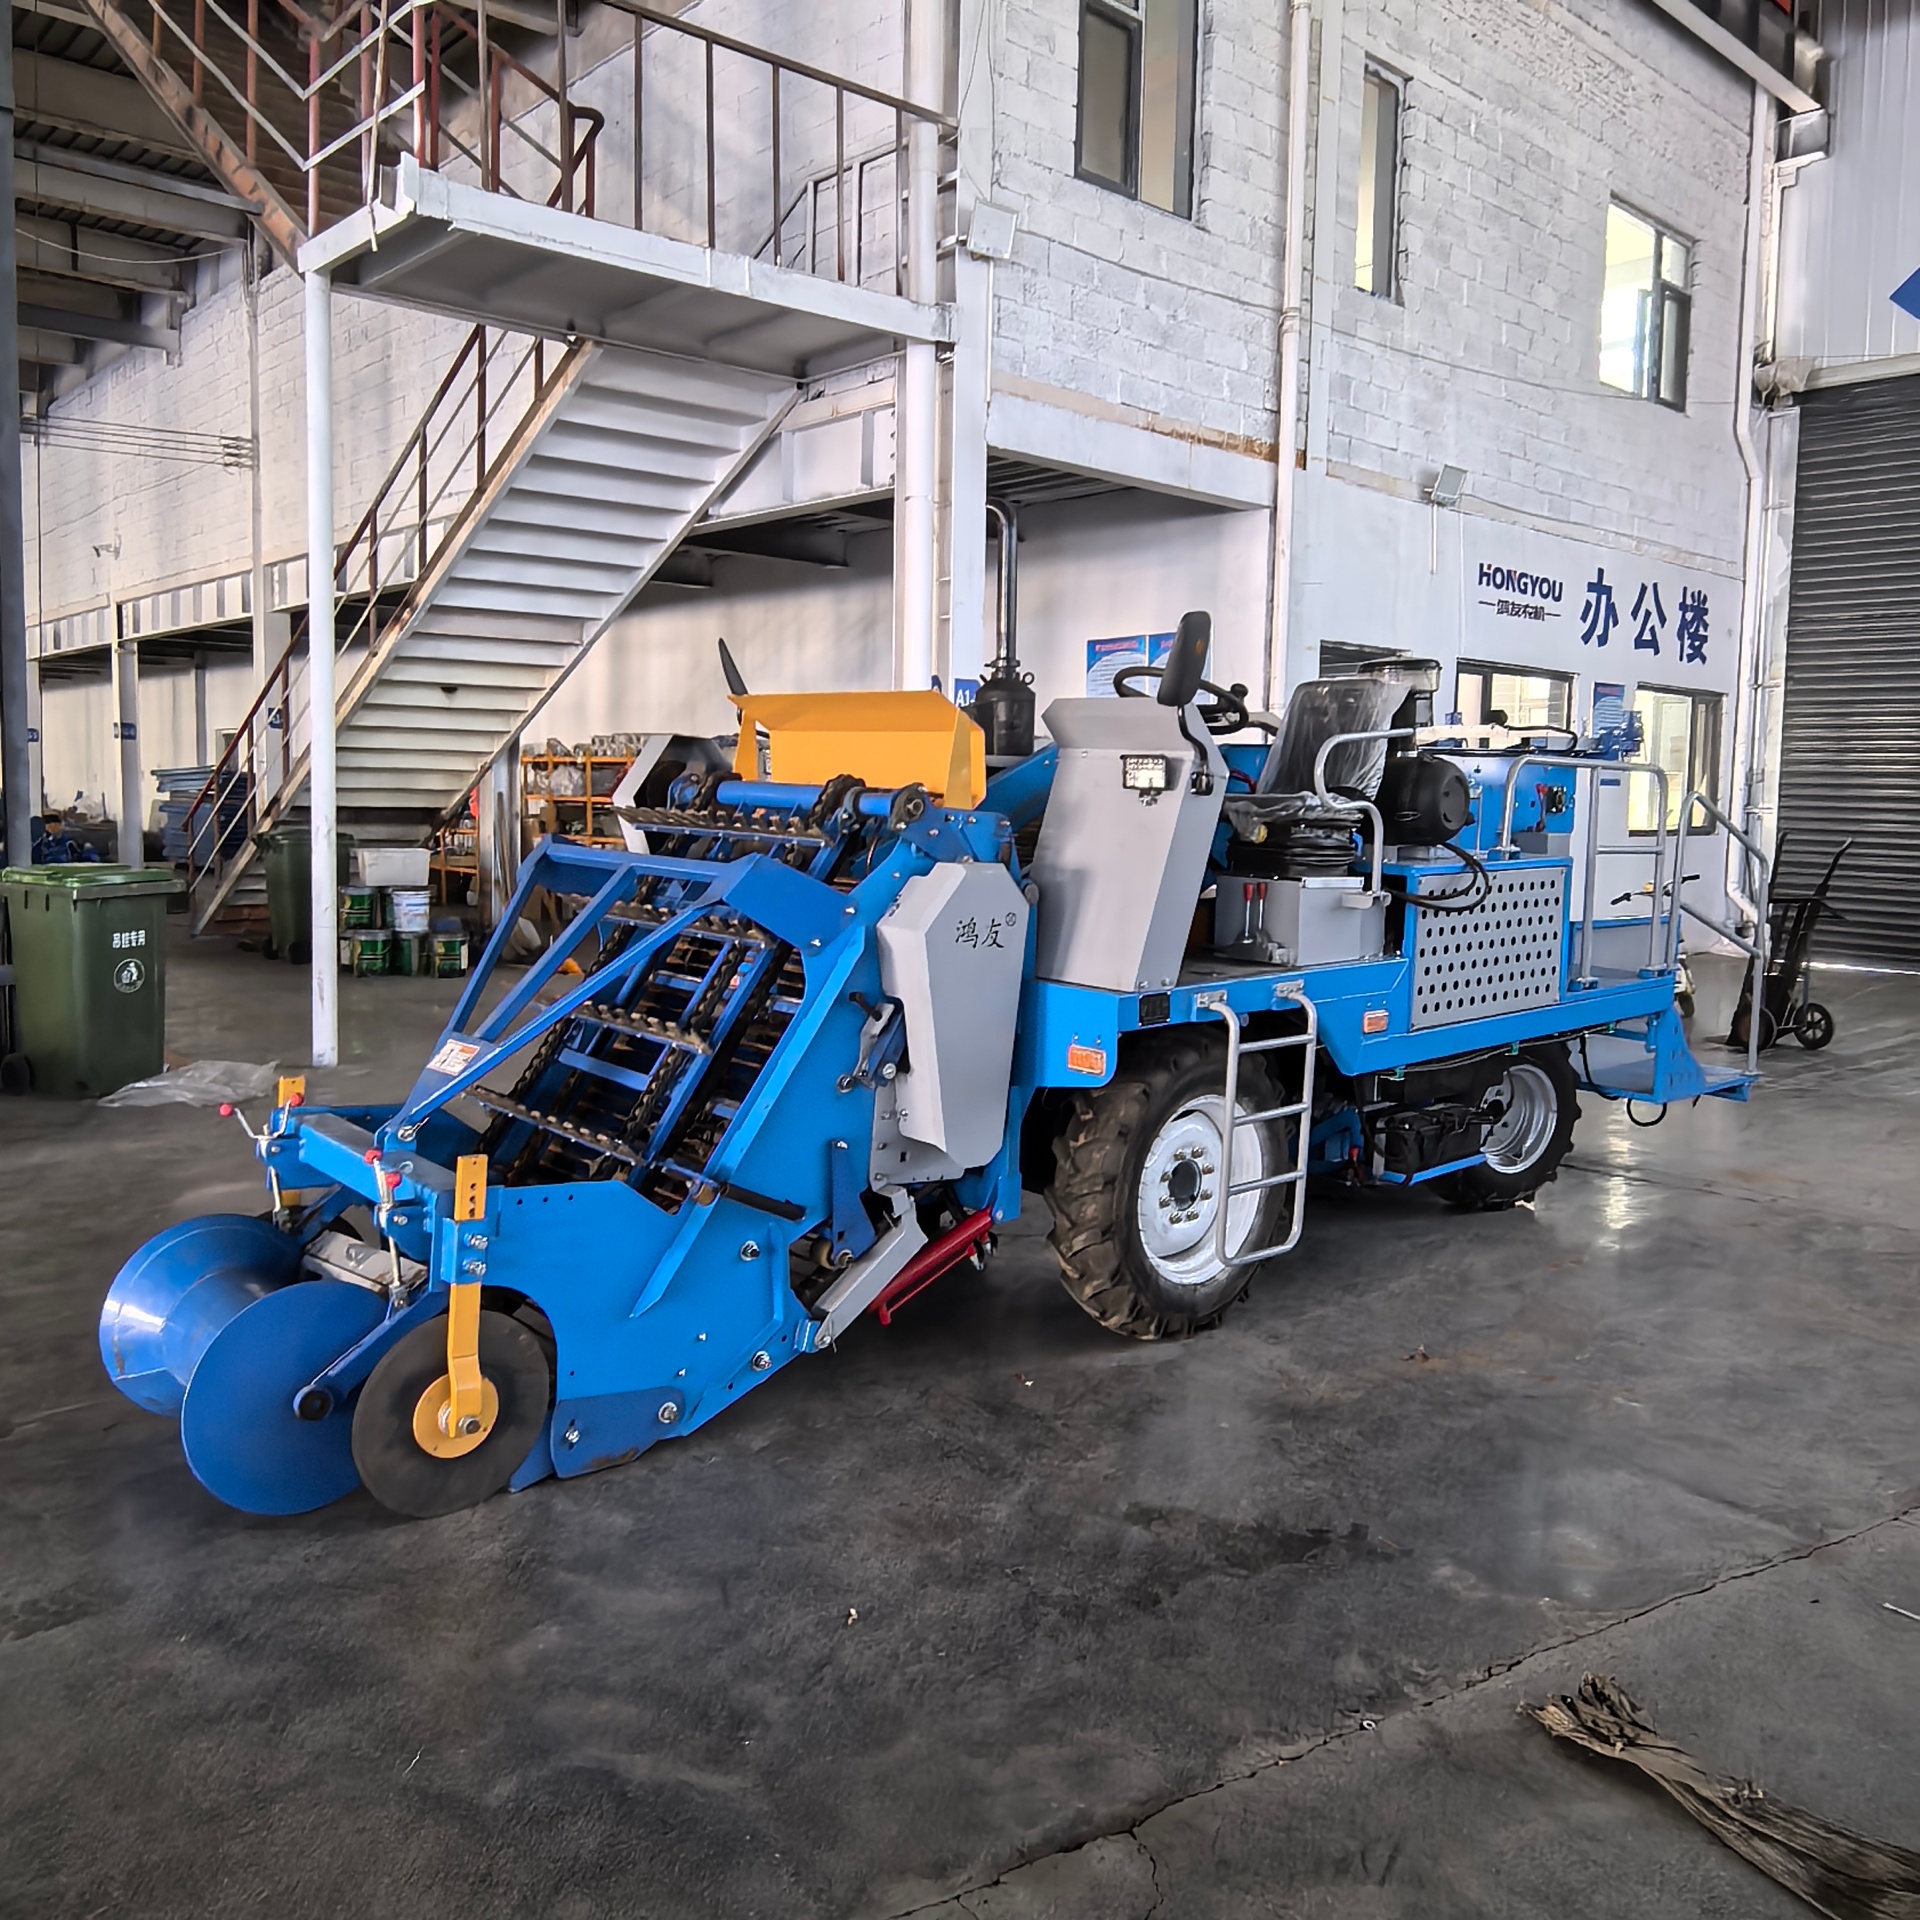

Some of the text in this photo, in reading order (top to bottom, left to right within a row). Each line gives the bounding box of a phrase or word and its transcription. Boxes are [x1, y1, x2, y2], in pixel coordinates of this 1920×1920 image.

[1478, 562, 1563, 602] HONGYOU
[1579, 567, 1710, 665] 办公楼
